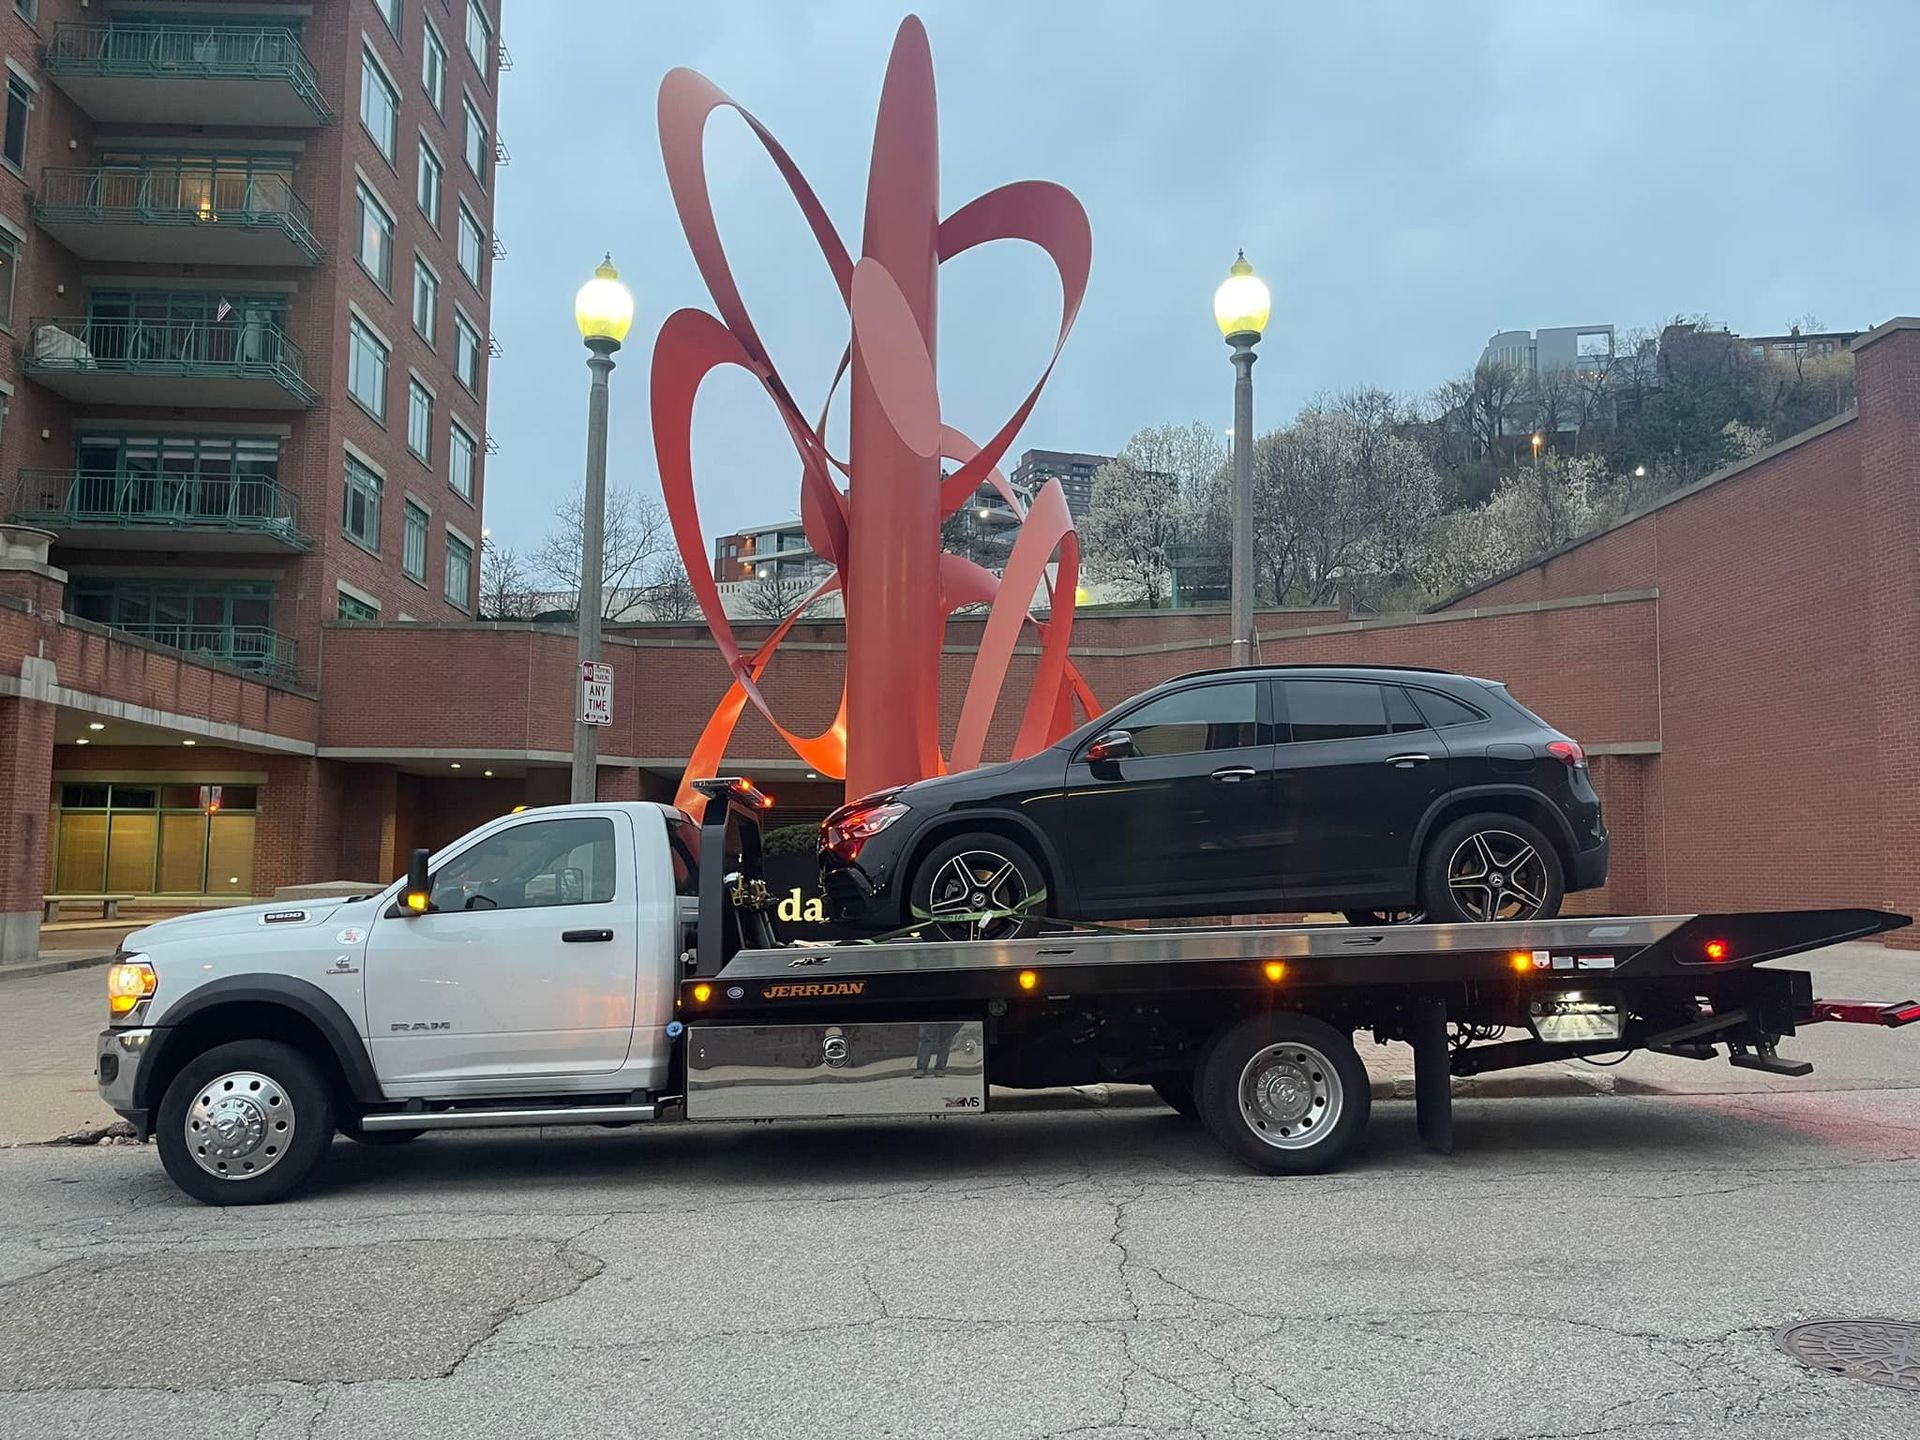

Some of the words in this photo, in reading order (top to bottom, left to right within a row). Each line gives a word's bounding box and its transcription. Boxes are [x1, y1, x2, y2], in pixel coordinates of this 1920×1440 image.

[584, 666, 593, 678] NO
[589, 685, 606, 697] ANY
[588, 699, 607, 712] TIME
[391, 1021, 450, 1031] RAM
